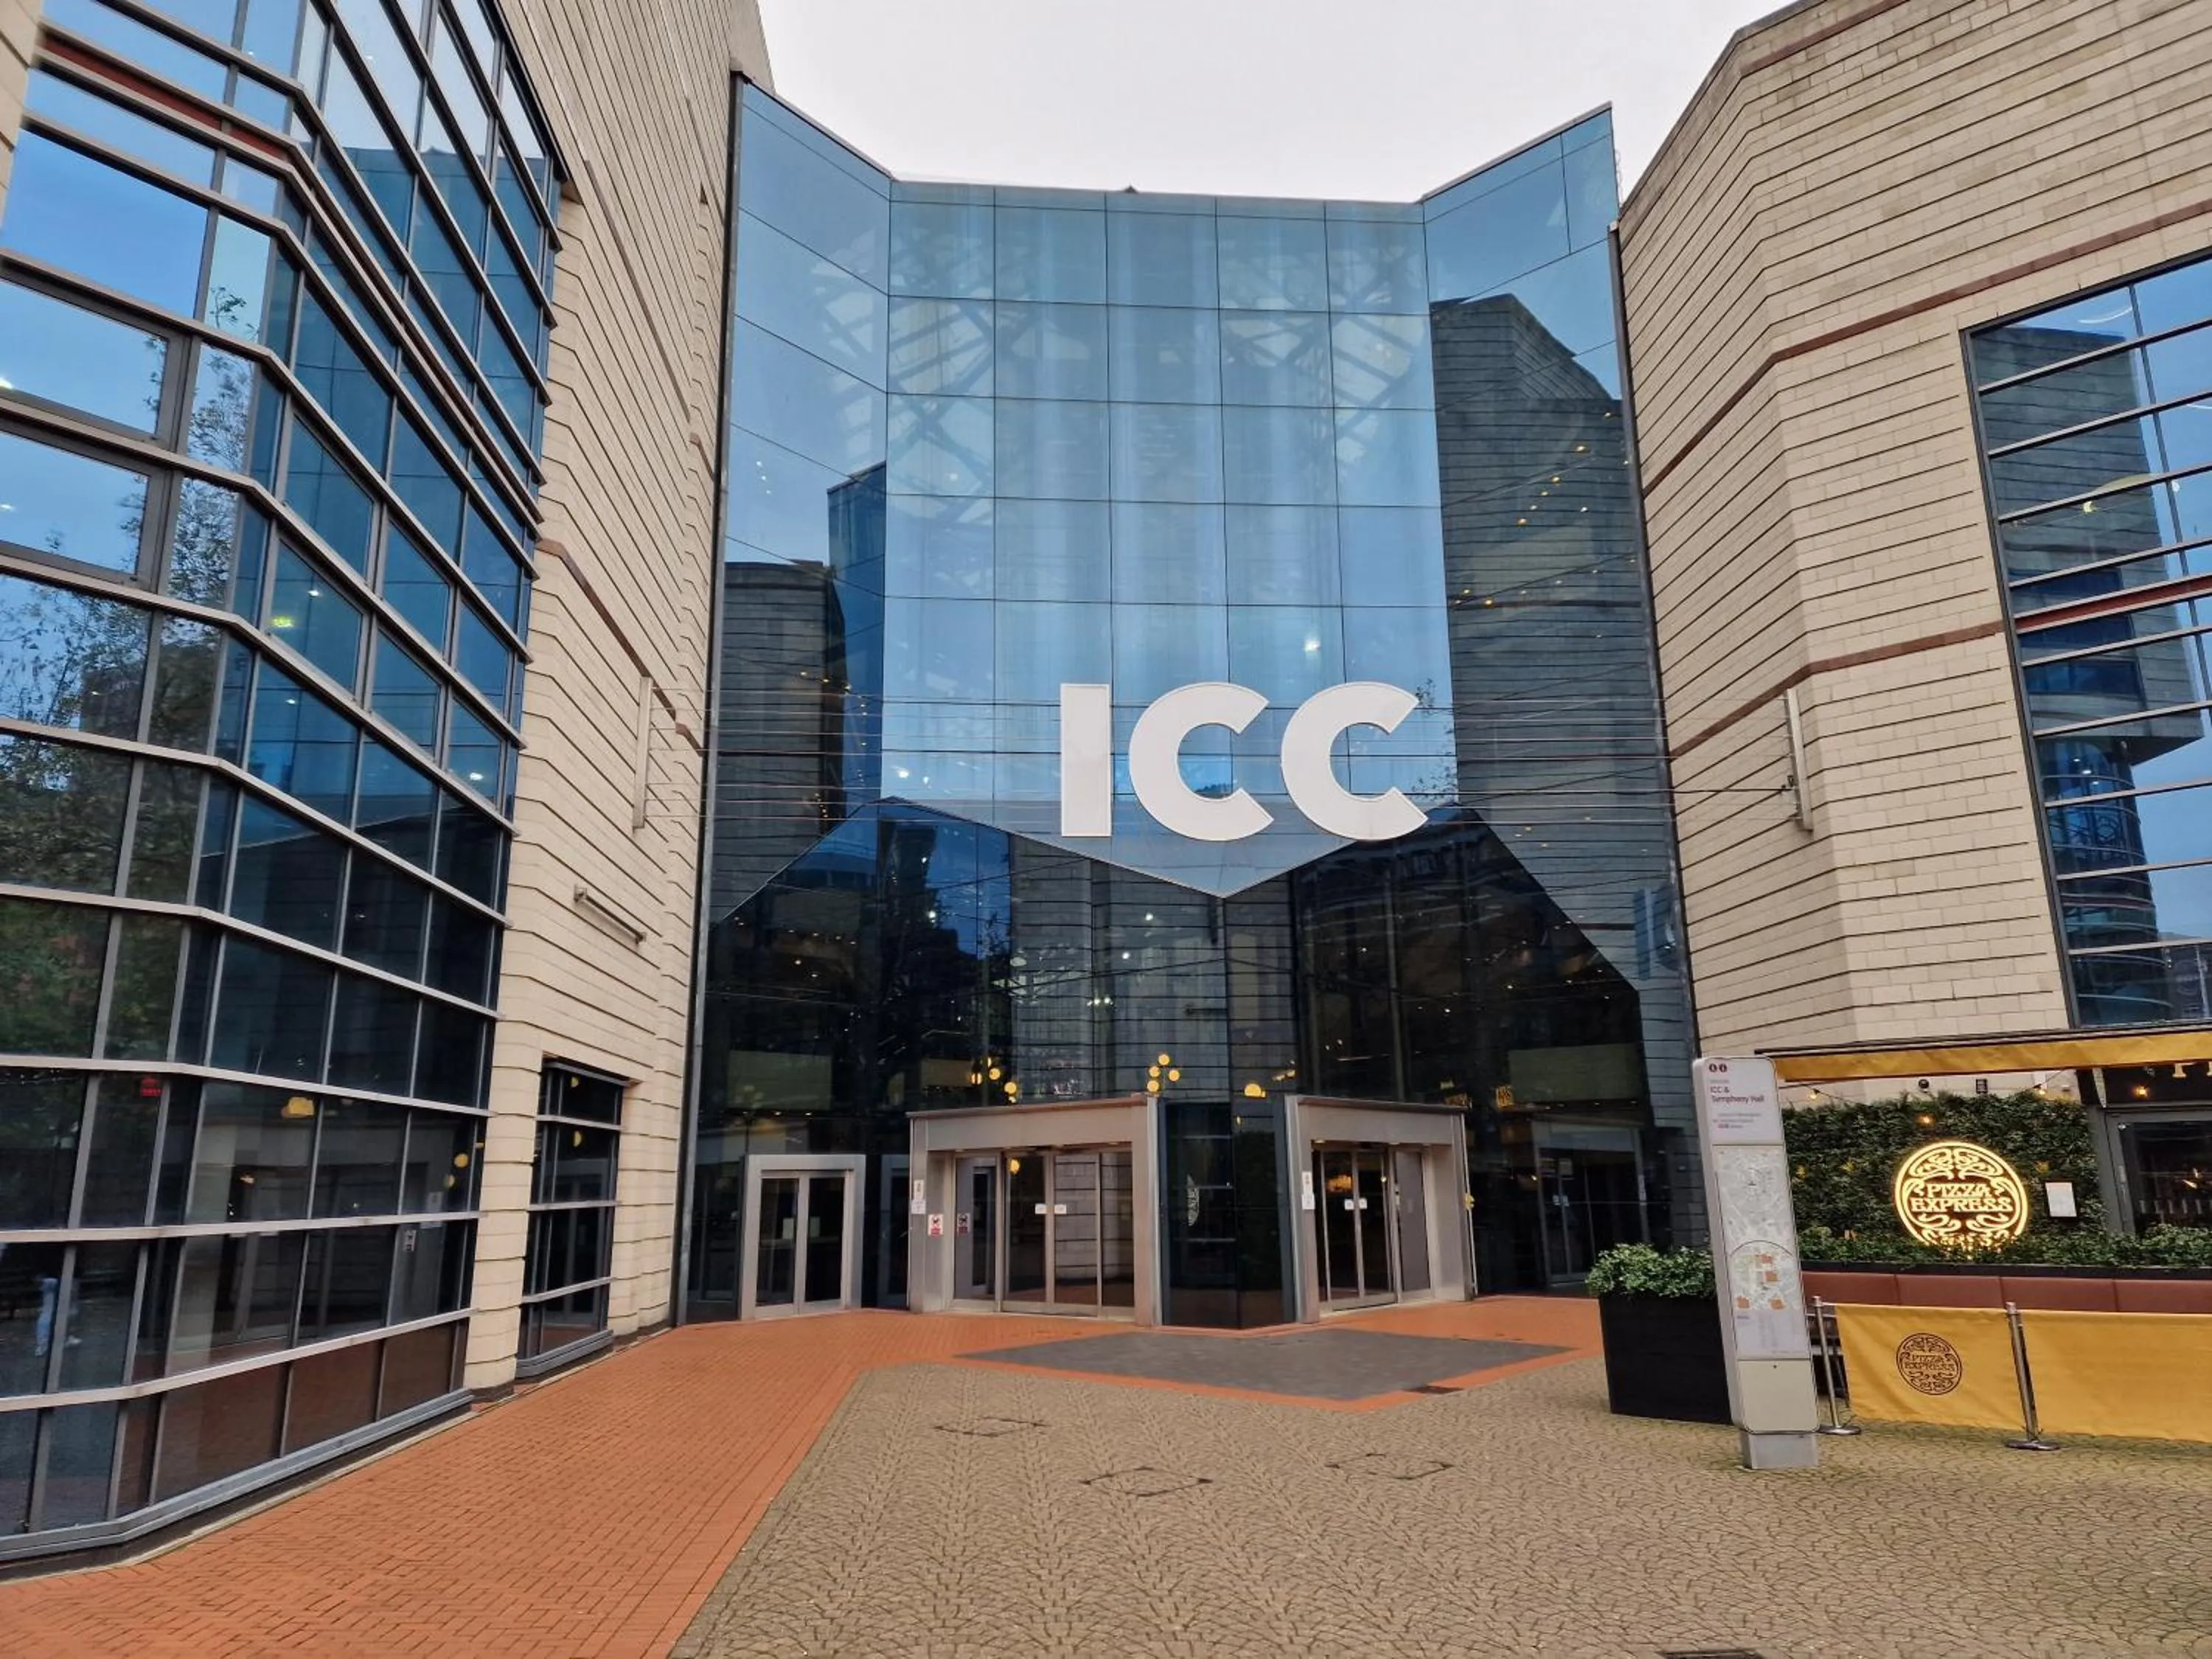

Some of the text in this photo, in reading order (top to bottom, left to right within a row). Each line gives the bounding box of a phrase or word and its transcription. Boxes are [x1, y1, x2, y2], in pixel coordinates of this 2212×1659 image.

[1060, 682, 1428, 841] ICC
[1711, 1094, 1765, 1105] Symphony Hall
[1926, 1183, 1992, 1198] PIZZA
[1910, 1196, 2014, 1213] EXPRESS
[1912, 1354, 1944, 1364] PIZZA
[1904, 1362, 1955, 1372] EXPRESS
